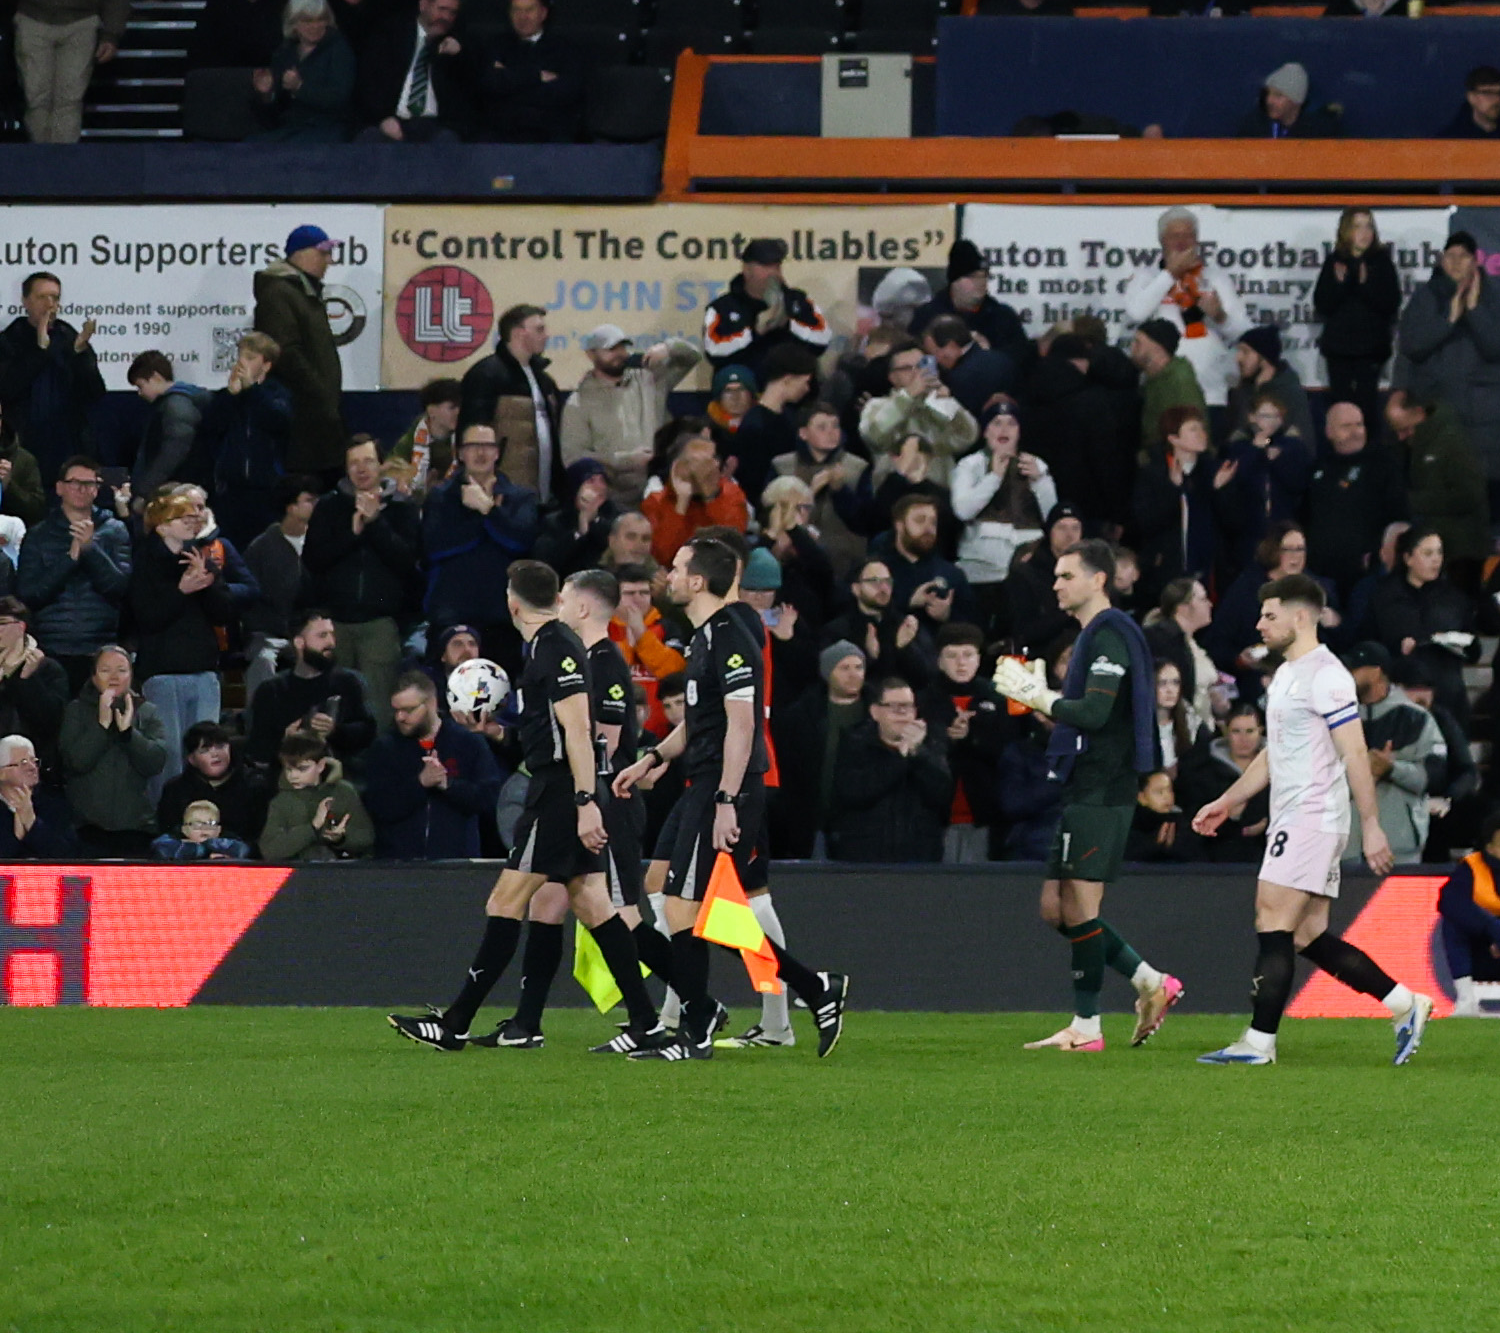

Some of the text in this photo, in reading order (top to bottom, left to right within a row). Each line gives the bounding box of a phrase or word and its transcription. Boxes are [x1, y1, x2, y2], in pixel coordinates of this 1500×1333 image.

[0, 236, 78, 266] uton
[579, 230, 643, 260] The
[984, 241, 1068, 268] uton
[1081, 241, 1162, 268] Tow
[545, 279, 661, 312] JOHN
[1039, 275, 1107, 295] most
[58, 302, 152, 319] ndependent
[94, 322, 171, 335] ince 1990
[1270, 831, 1288, 857] 8
